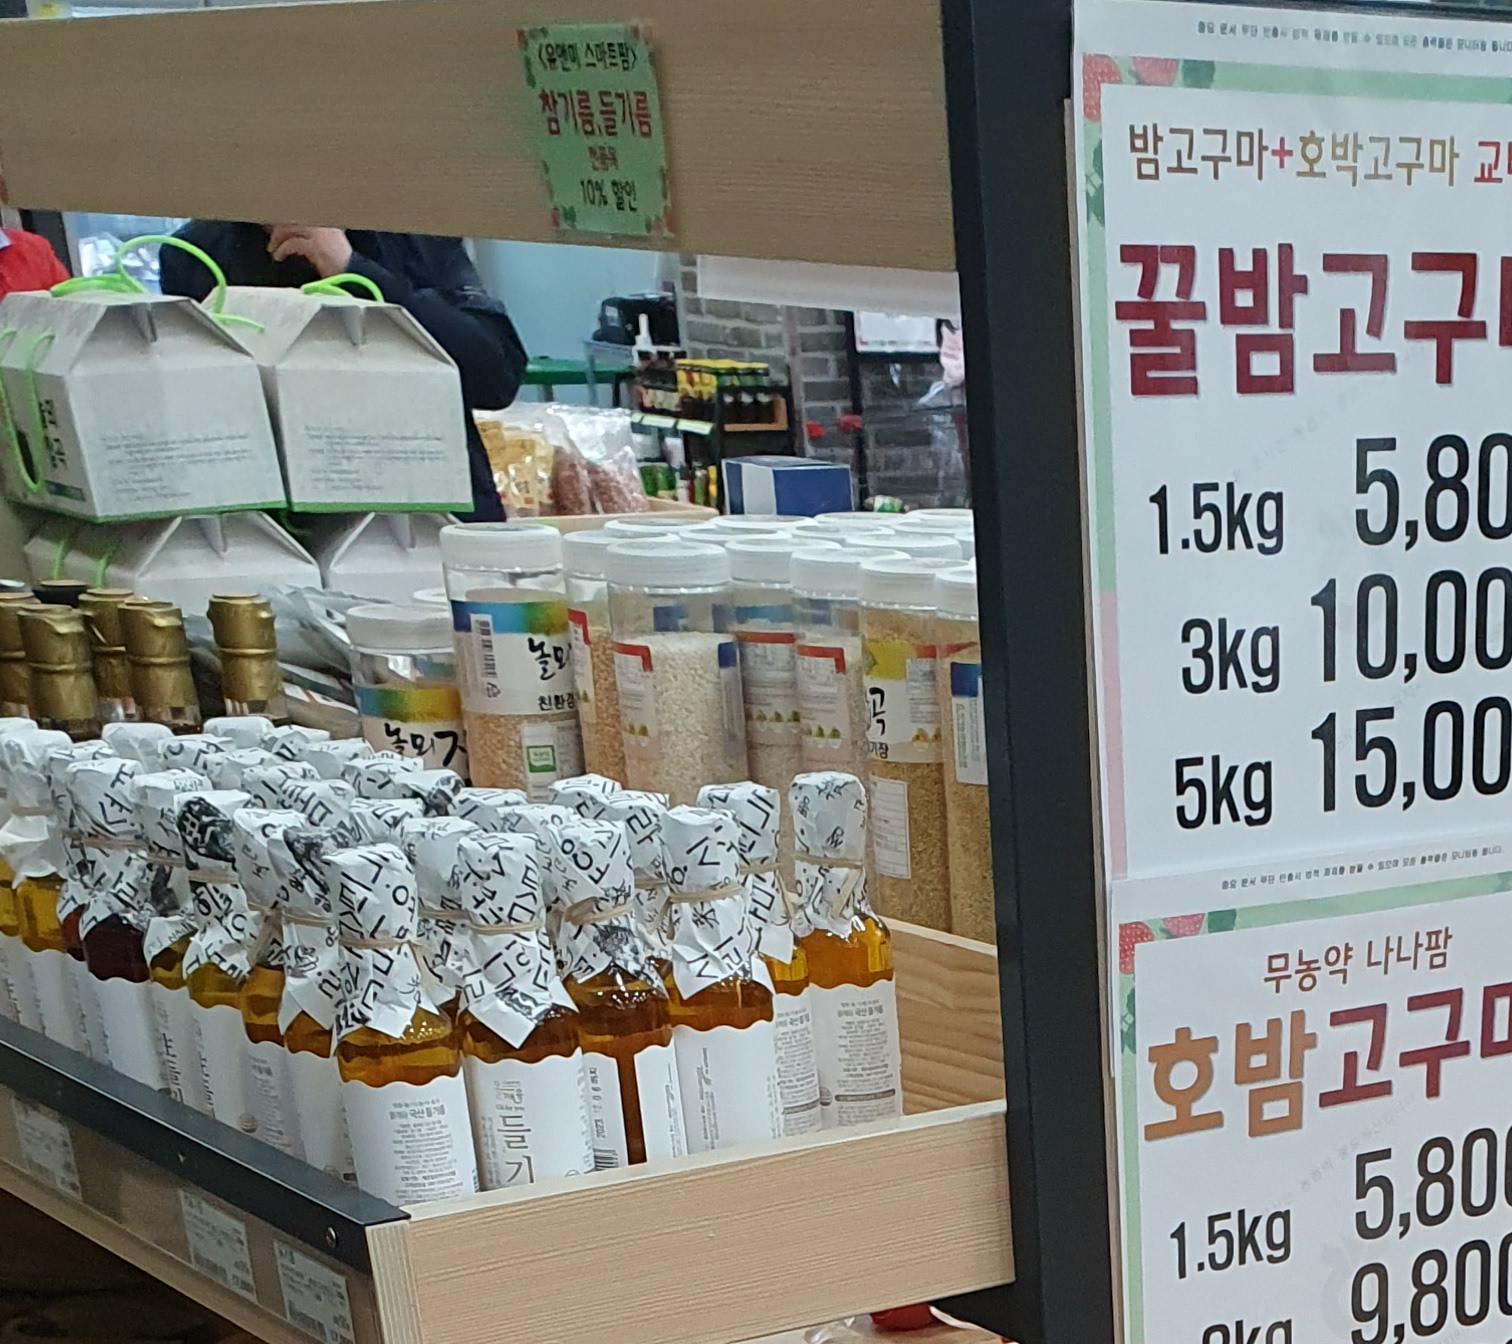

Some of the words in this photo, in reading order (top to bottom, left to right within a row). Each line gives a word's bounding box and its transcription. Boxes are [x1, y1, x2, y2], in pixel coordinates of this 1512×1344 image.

[580, 178, 608, 207] 10%
[611, 179, 638, 212] 할인
[1149, 482, 1286, 556] 1.5kg
[1181, 619, 1281, 695] 3kg
[1174, 756, 1274, 829] 5kg
[1263, 941, 1355, 992] 무농약
[1364, 927, 1454, 976] 나나팜
[1170, 1206, 1293, 1280] 1.5kg
